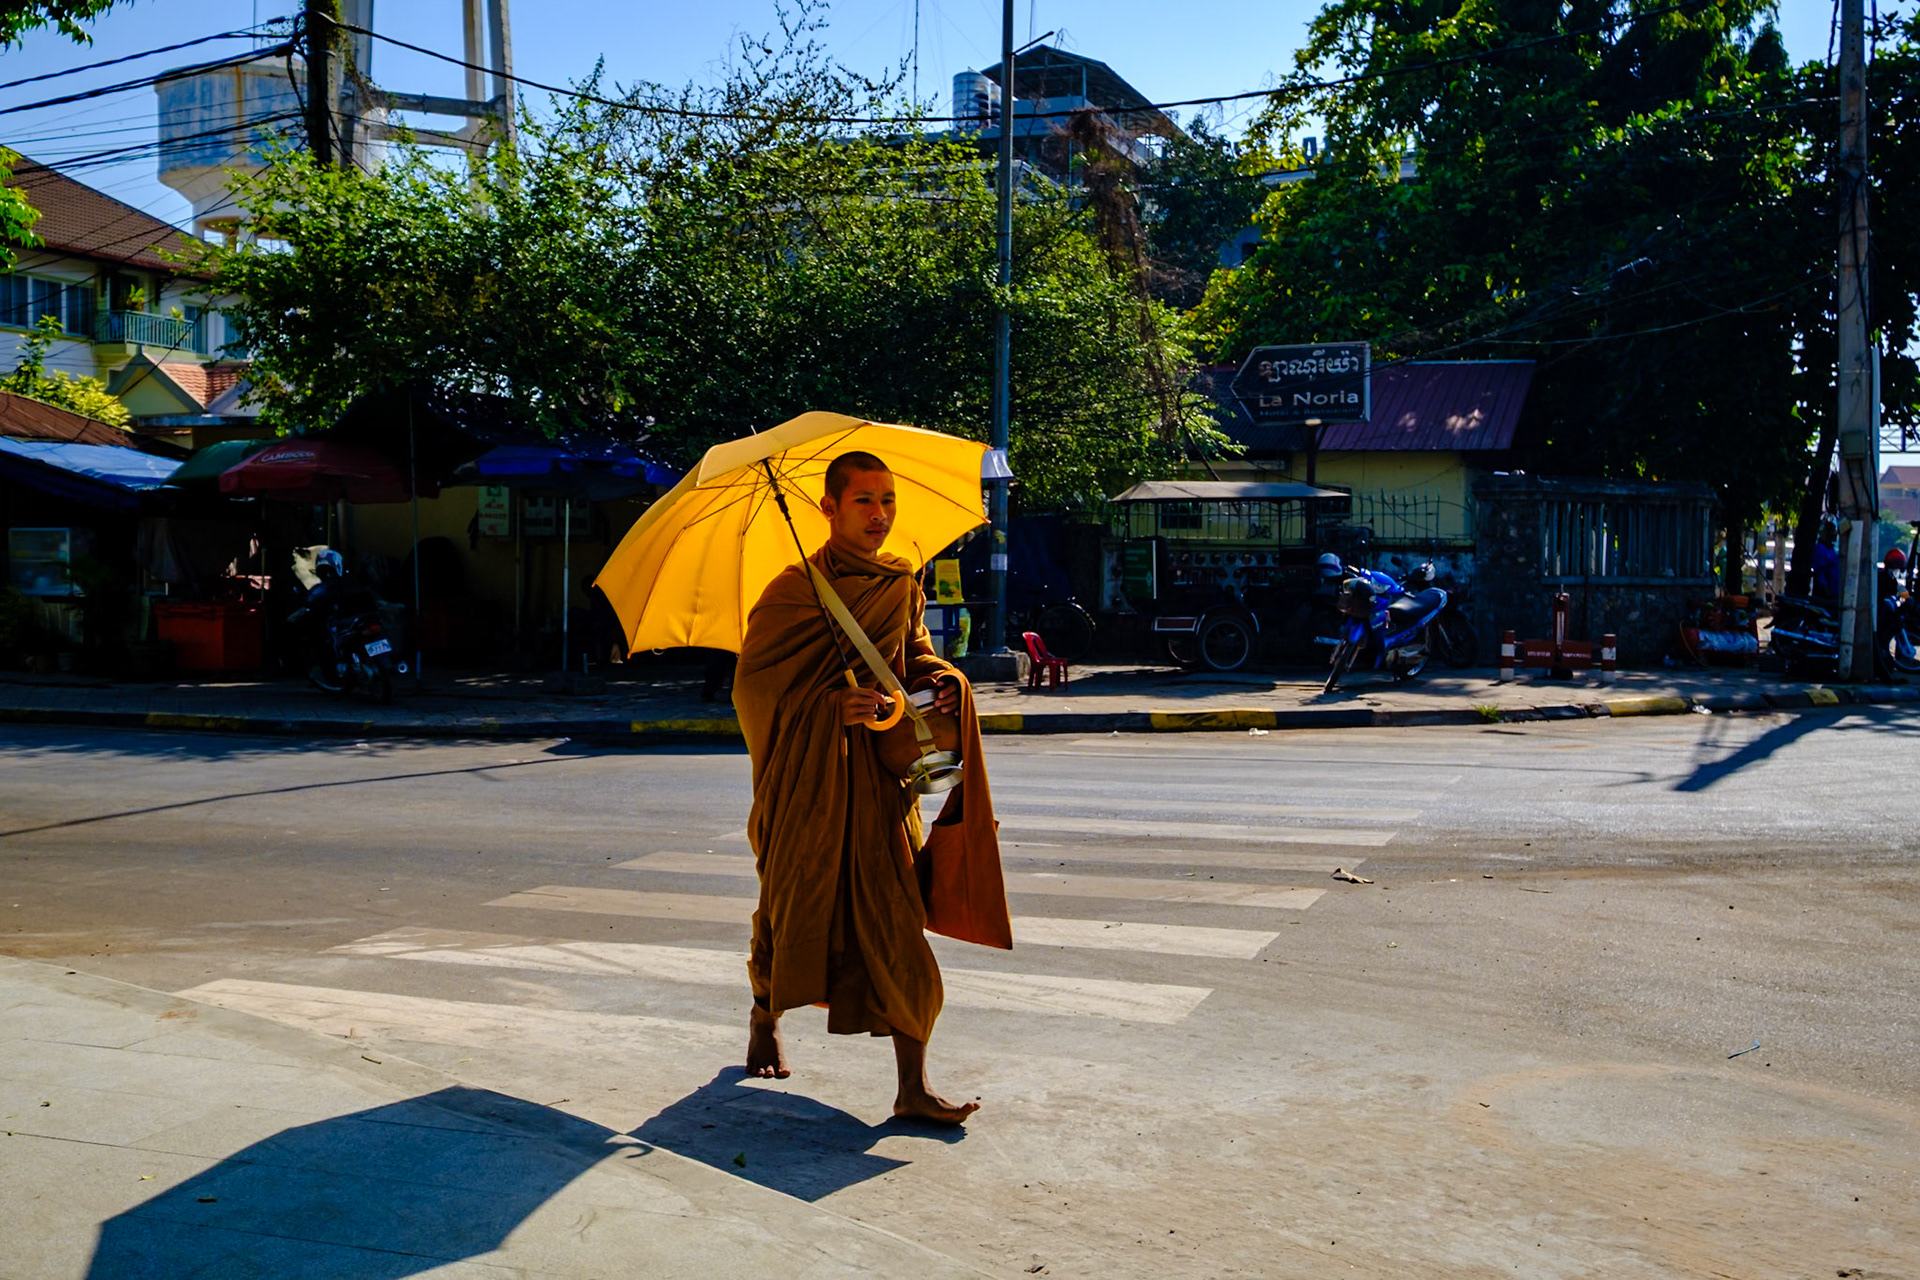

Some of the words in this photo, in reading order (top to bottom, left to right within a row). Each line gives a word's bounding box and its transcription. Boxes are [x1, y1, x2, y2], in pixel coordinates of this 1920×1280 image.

[1259, 395, 1283, 408] La
[1292, 390, 1359, 406] Noria
[261, 451, 315, 463] CAMBODIA
